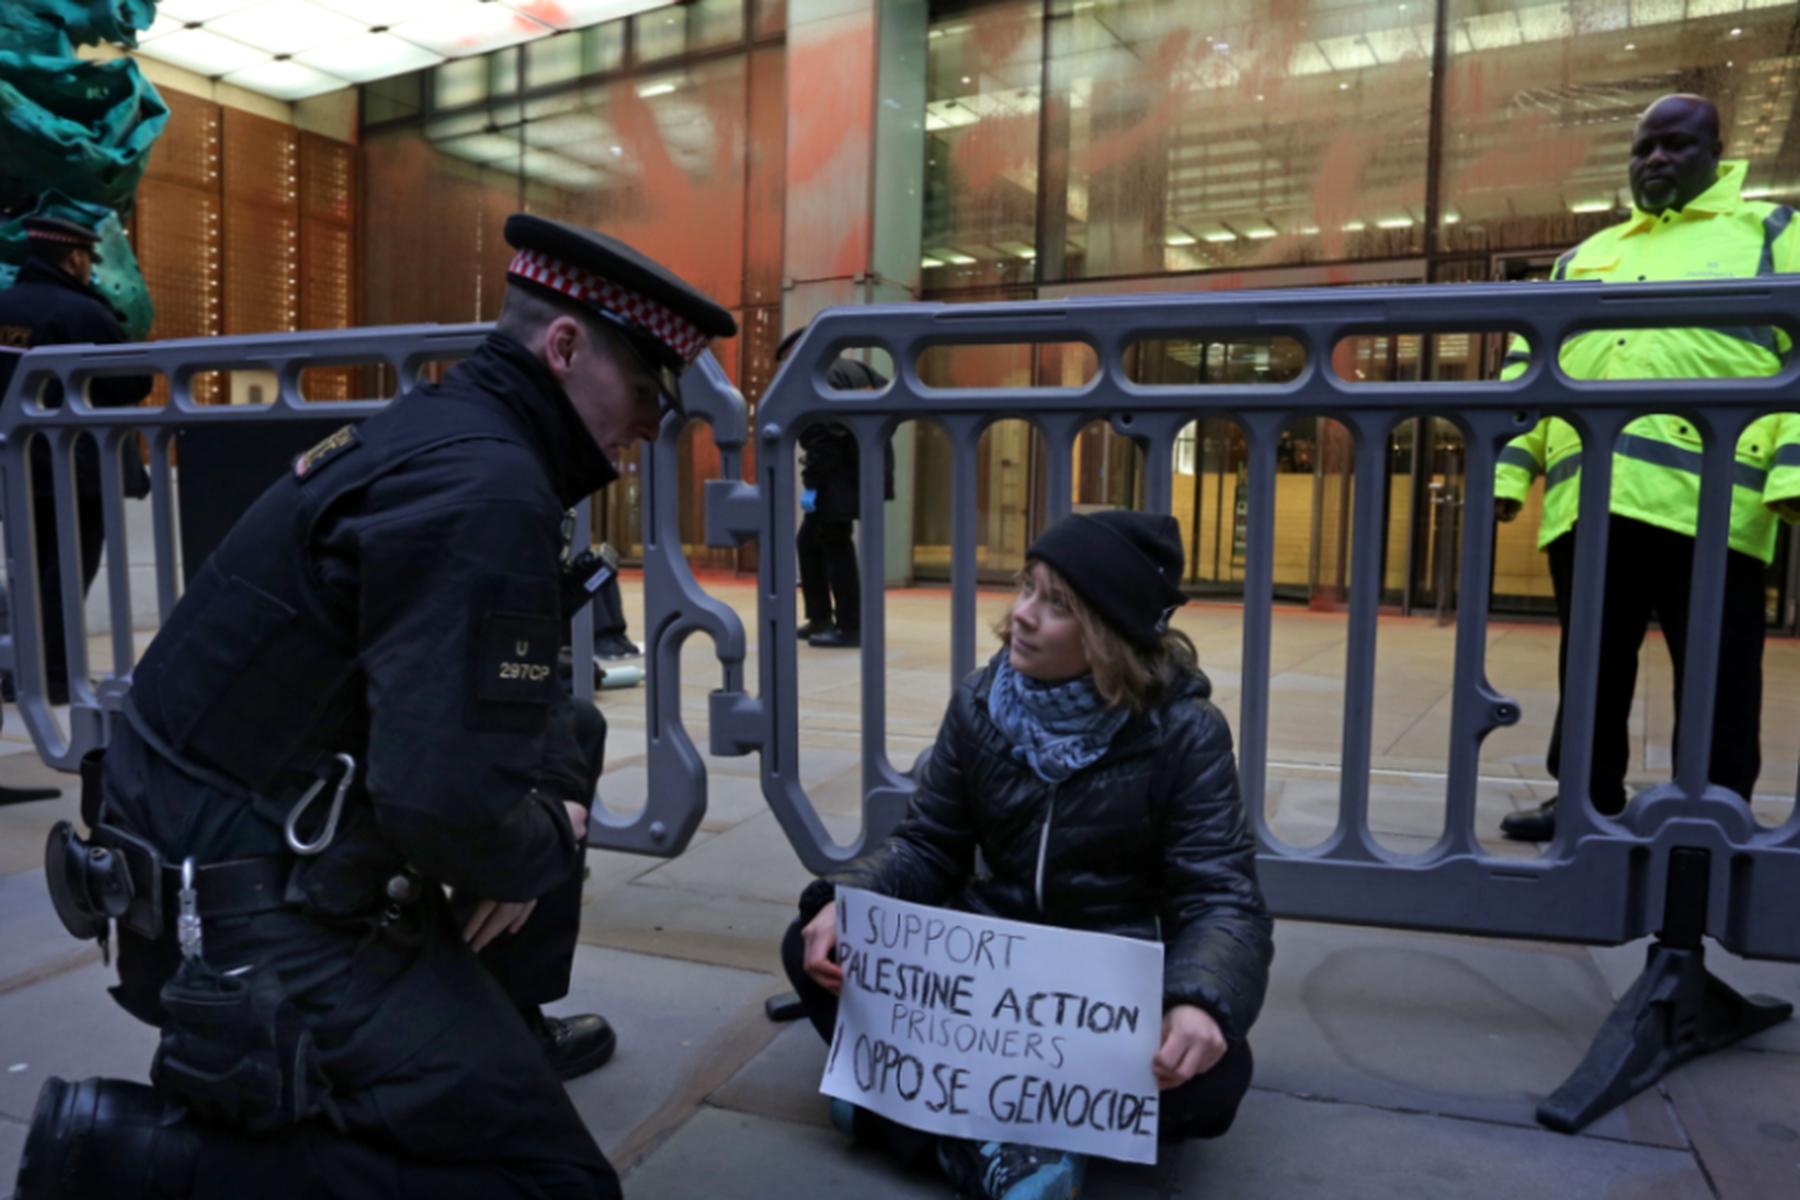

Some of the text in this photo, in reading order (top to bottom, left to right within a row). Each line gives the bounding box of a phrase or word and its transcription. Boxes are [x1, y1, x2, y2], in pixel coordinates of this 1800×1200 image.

[499, 661, 551, 681] 297CP
[516, 640, 529, 656] U
[840, 896, 1026, 969] I SUPPORT
[838, 942, 1139, 1034] PALESTINE ACTION
[891, 1003, 1065, 1069] PRISONERS
[827, 1022, 1158, 1136] I OPPOSE GENOCIDE
